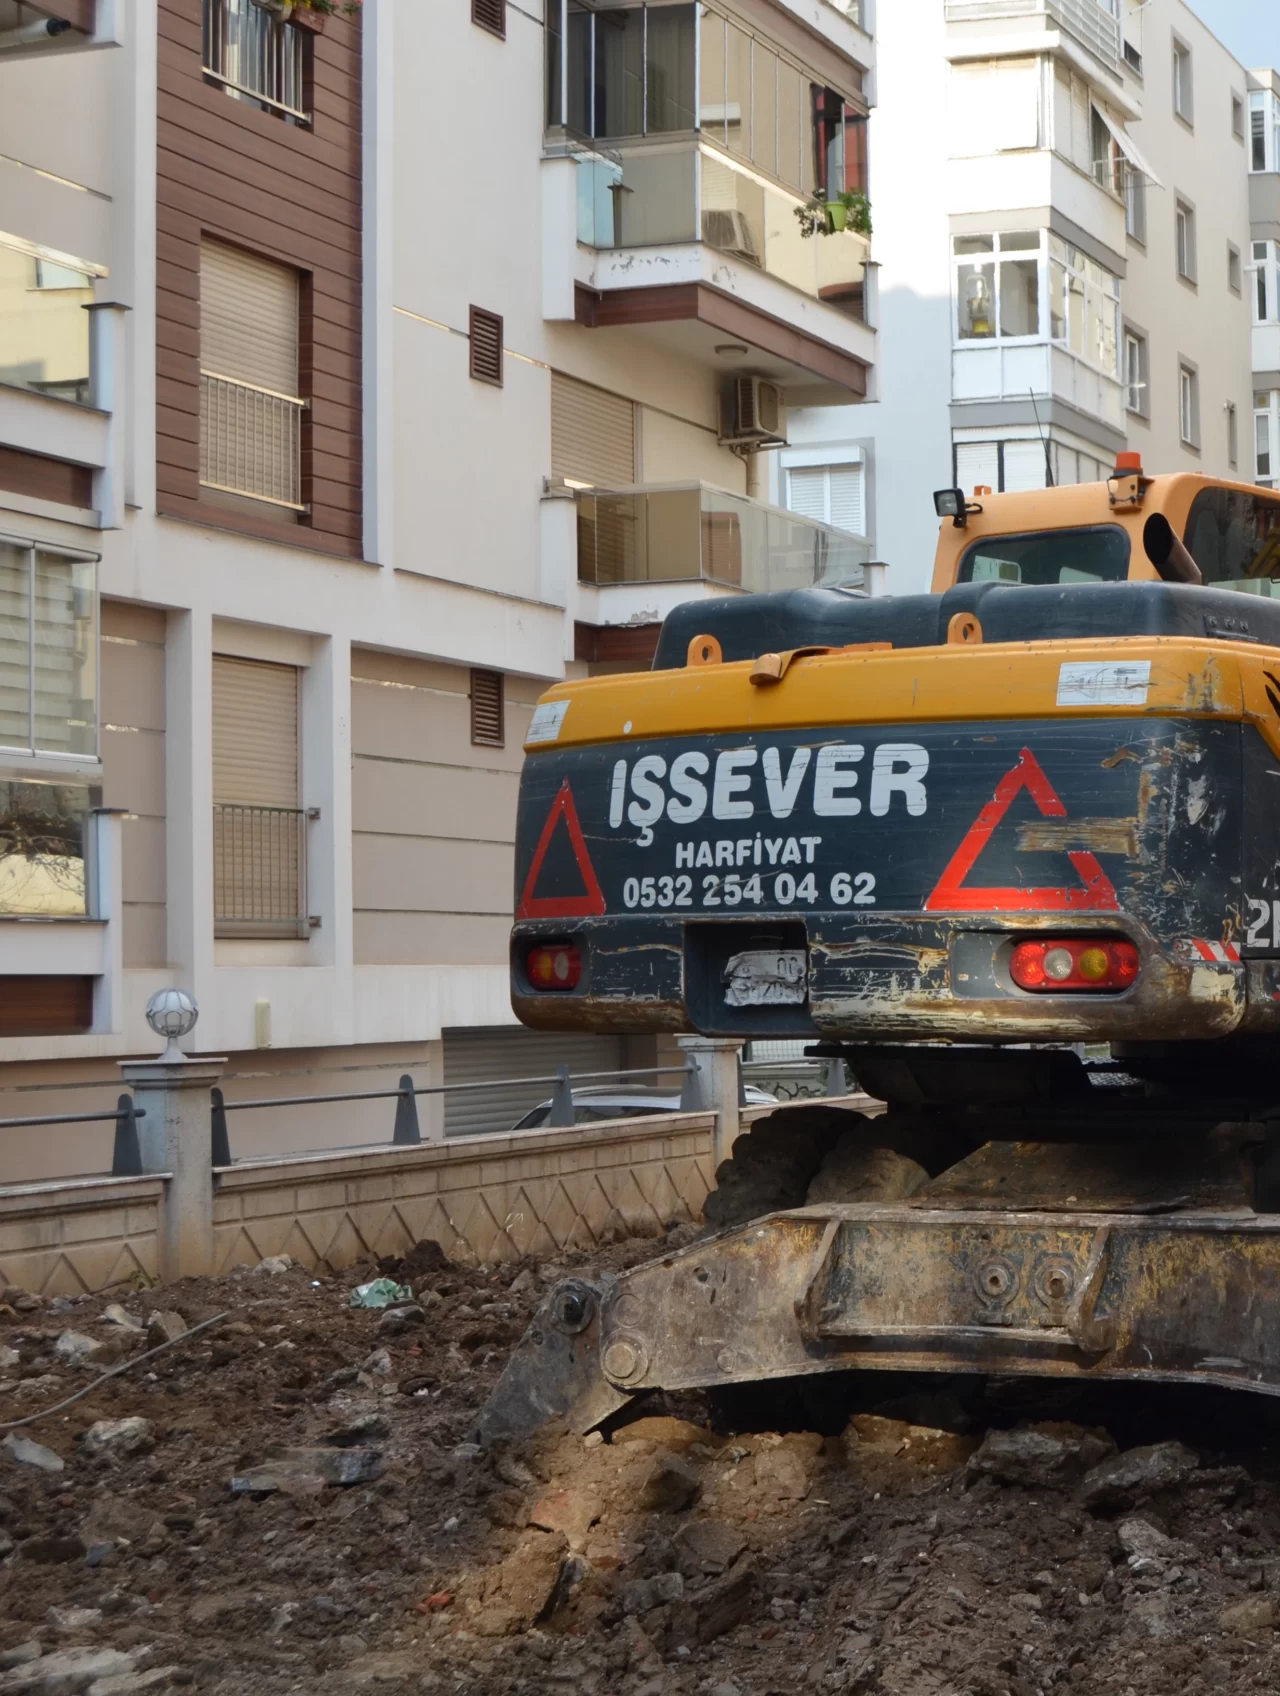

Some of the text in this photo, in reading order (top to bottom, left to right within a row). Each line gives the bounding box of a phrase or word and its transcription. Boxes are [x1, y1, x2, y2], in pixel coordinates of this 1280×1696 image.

[675, 832, 822, 869] HARFİYAT
[623, 872, 876, 908] 0532 254 04 62
